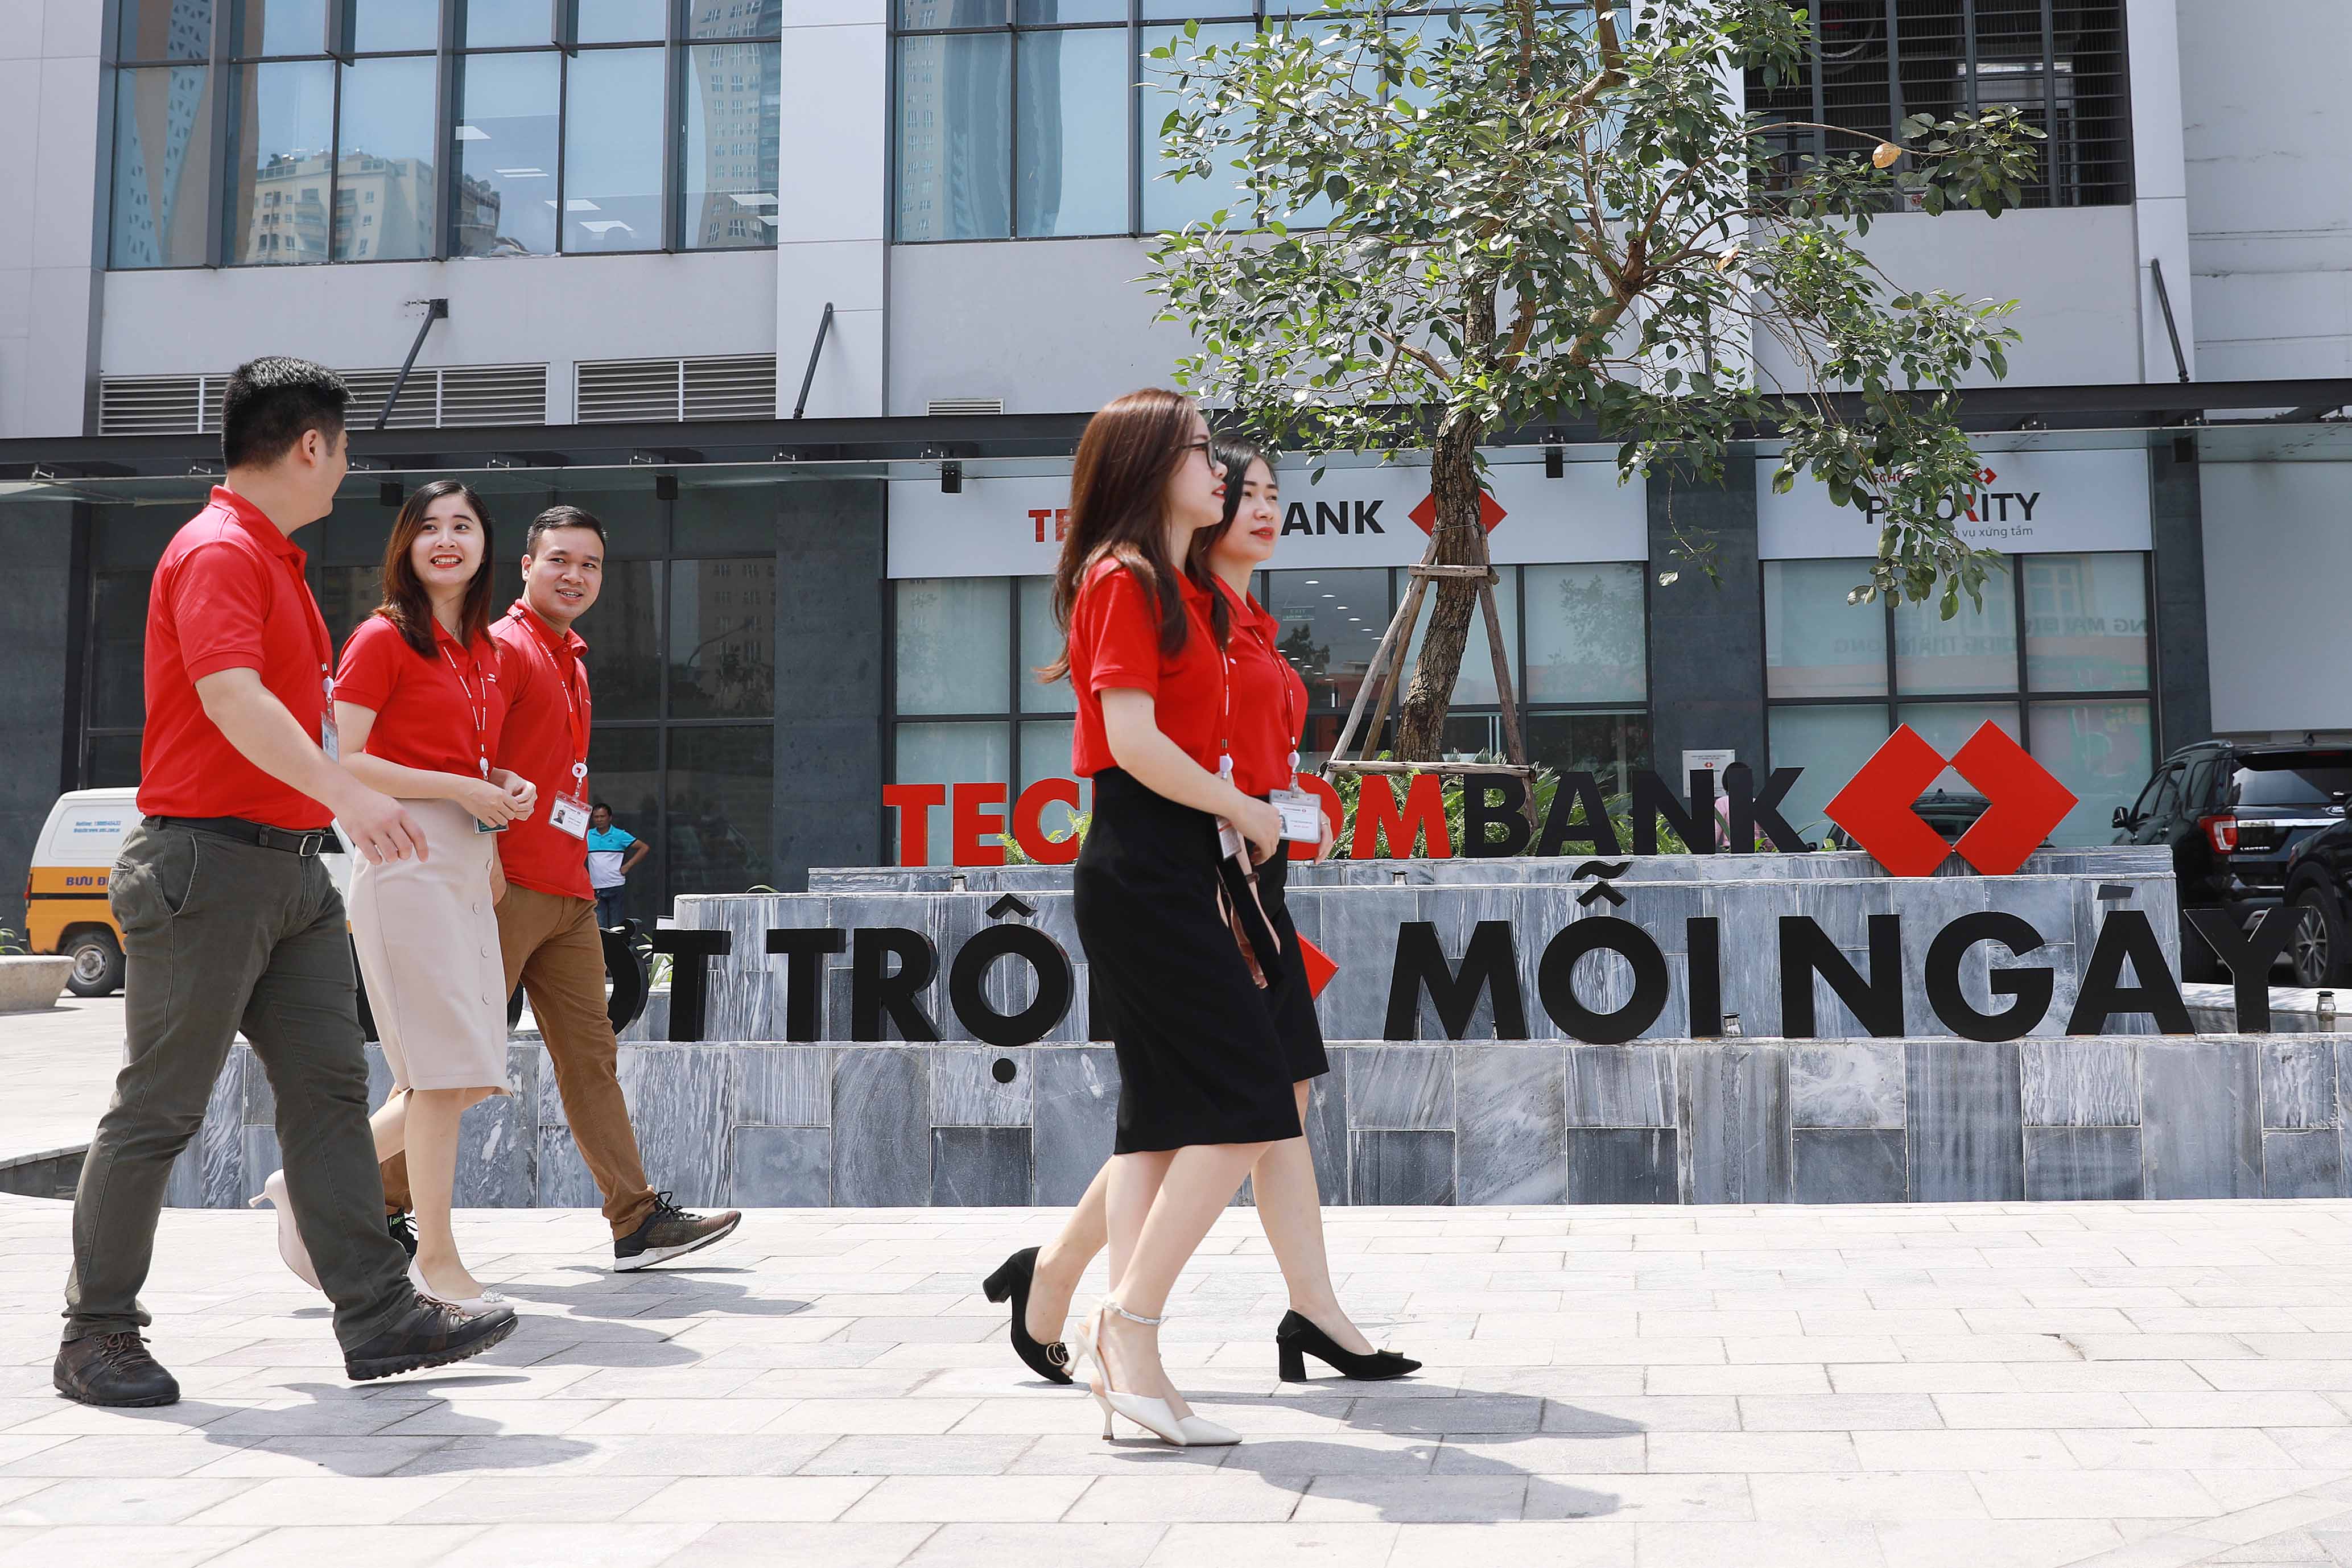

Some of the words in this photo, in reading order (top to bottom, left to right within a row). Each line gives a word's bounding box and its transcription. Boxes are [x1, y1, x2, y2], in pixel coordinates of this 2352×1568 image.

[883, 767, 1809, 867] TECMBANK
[766, 893, 1116, 1084] TRỘ
[1384, 861, 1724, 1046] MỖI
